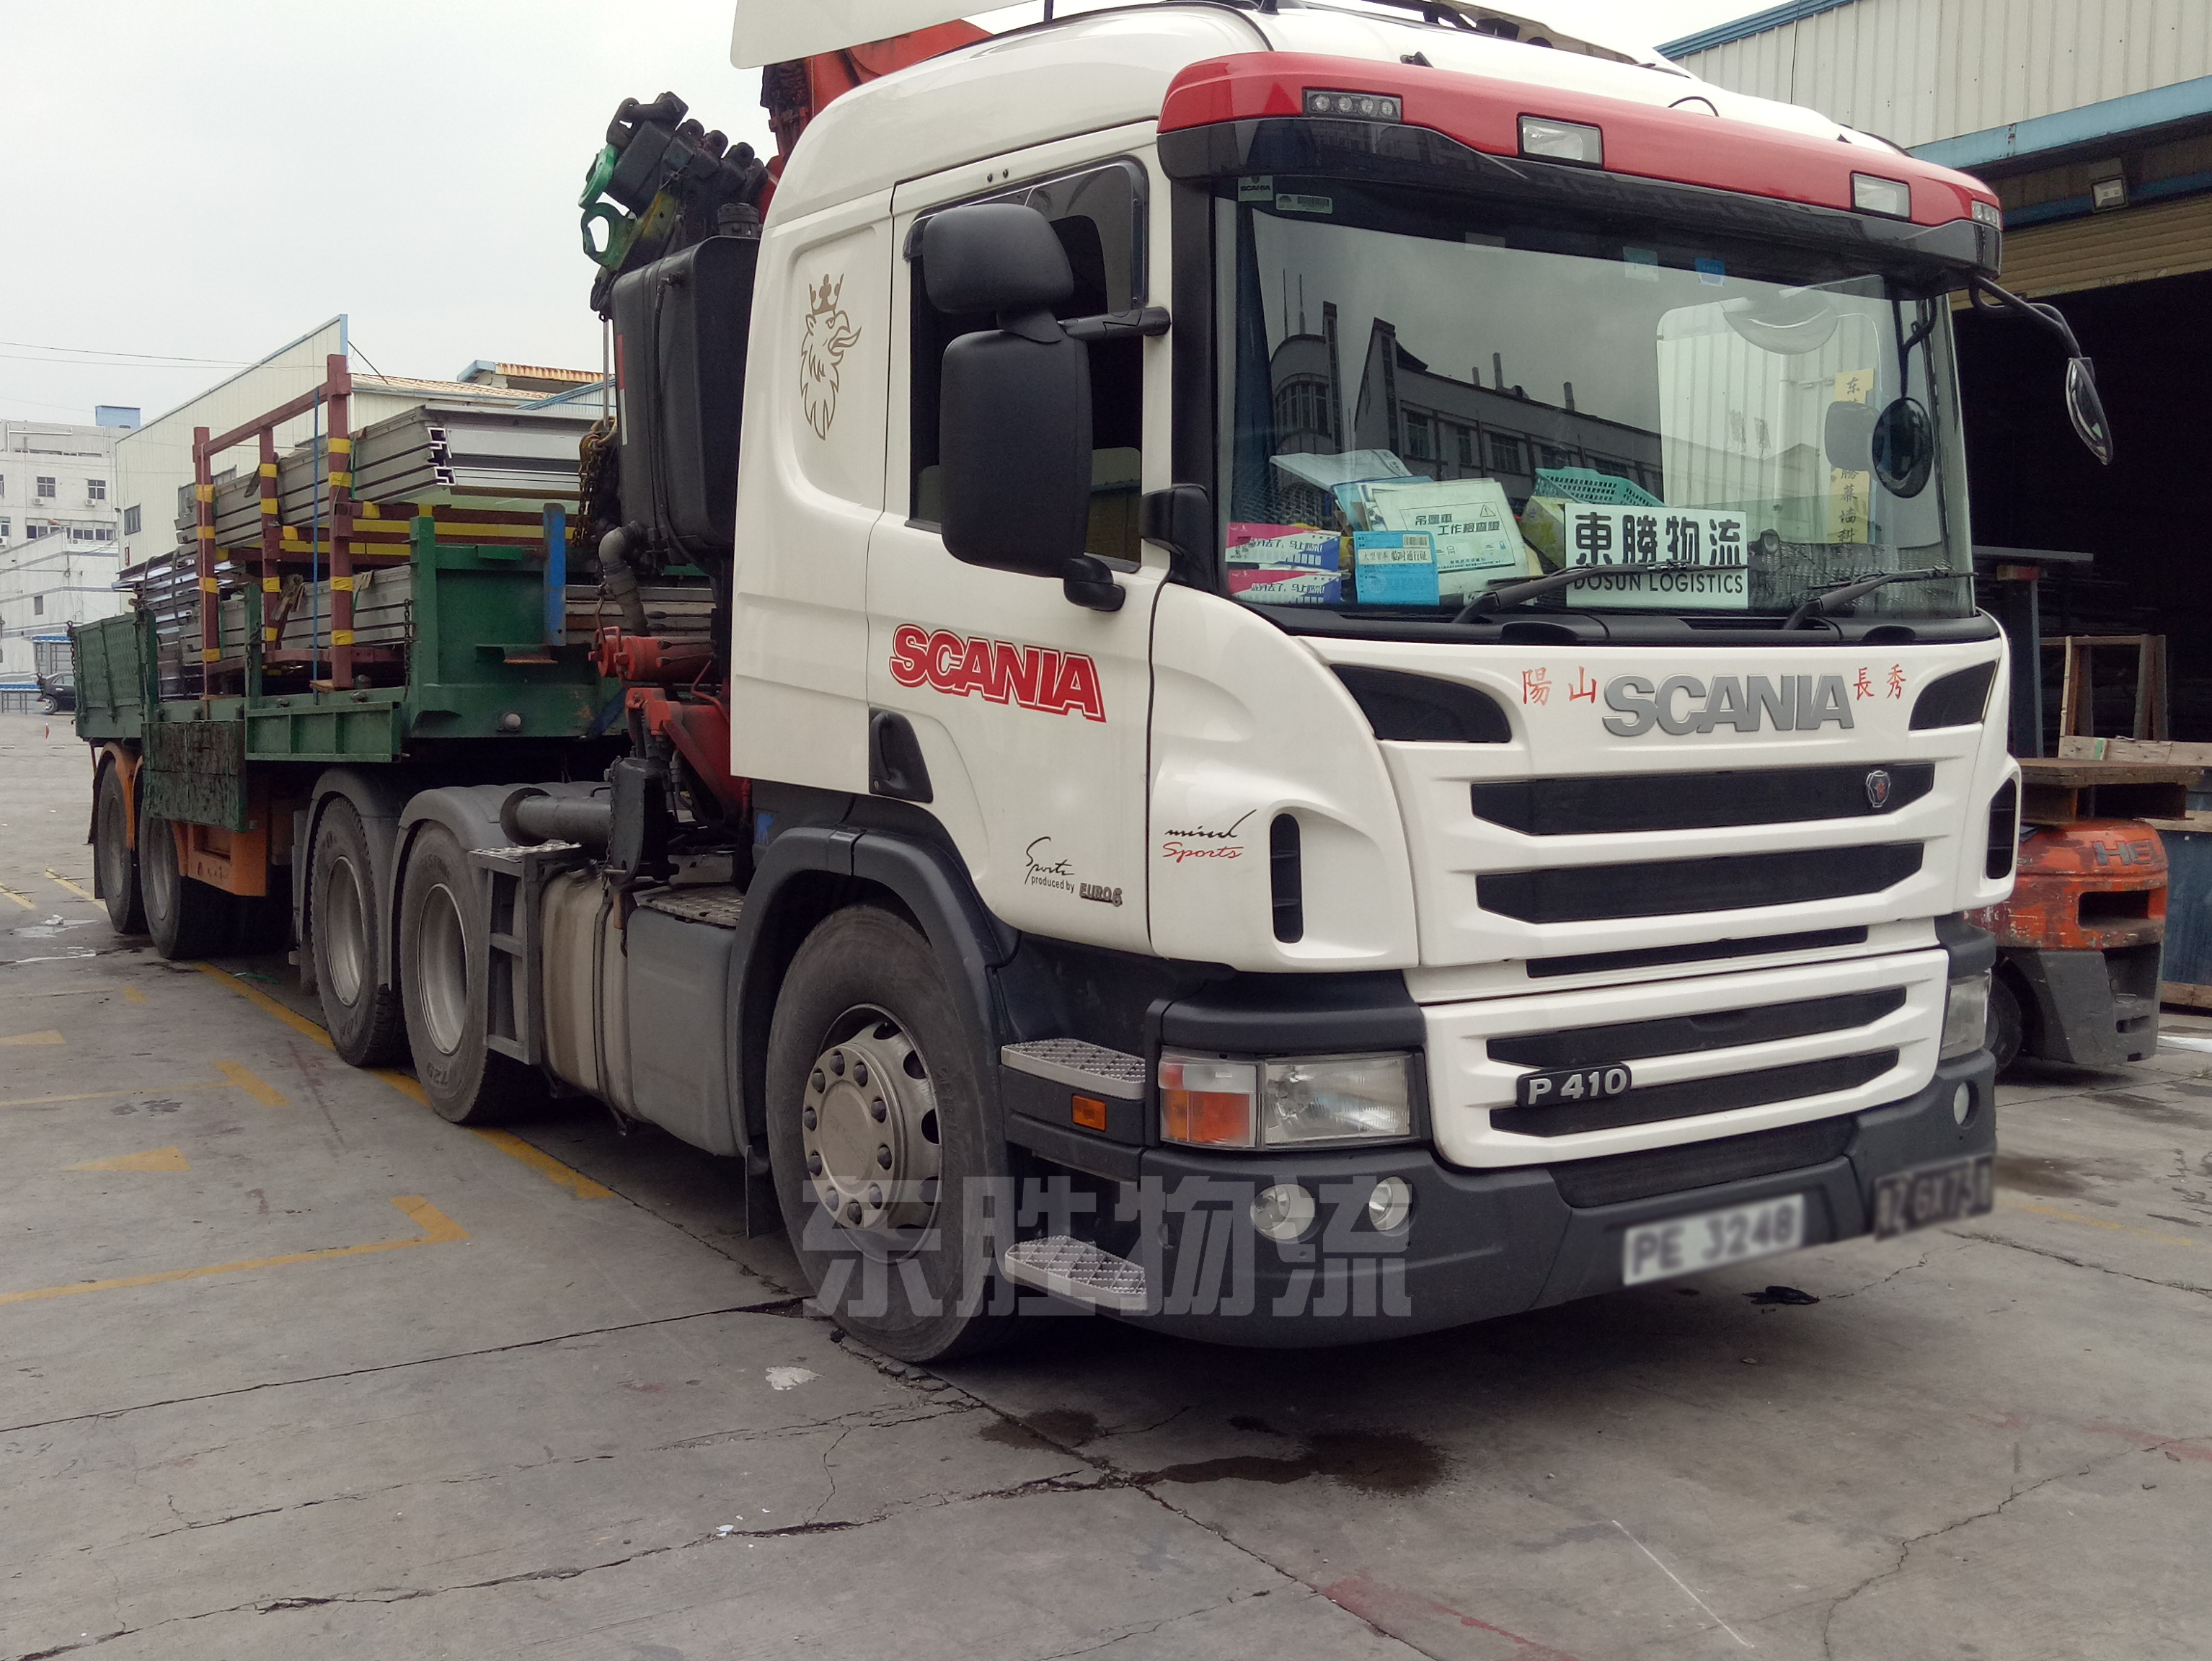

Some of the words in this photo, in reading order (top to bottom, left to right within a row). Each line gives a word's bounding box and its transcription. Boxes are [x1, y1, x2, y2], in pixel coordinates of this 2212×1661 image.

[1575, 511, 1741, 566] 東勝物流
[1573, 573, 1642, 592] DOSUN
[1648, 573, 1743, 594] LOGISTICS
[888, 624, 1107, 723] SCANIA
[1521, 665, 1598, 707] 陽山
[1852, 663, 1907, 701] 長秀
[1601, 673, 1855, 738] SCANIA
[1164, 809, 1257, 838] mind
[1162, 841, 1244, 864] Sports
[1031, 876, 1065, 890] produced
[1066, 880, 1075, 894] by
[1527, 1078, 1553, 1105] P
[1560, 1068, 1628, 1100] 410
